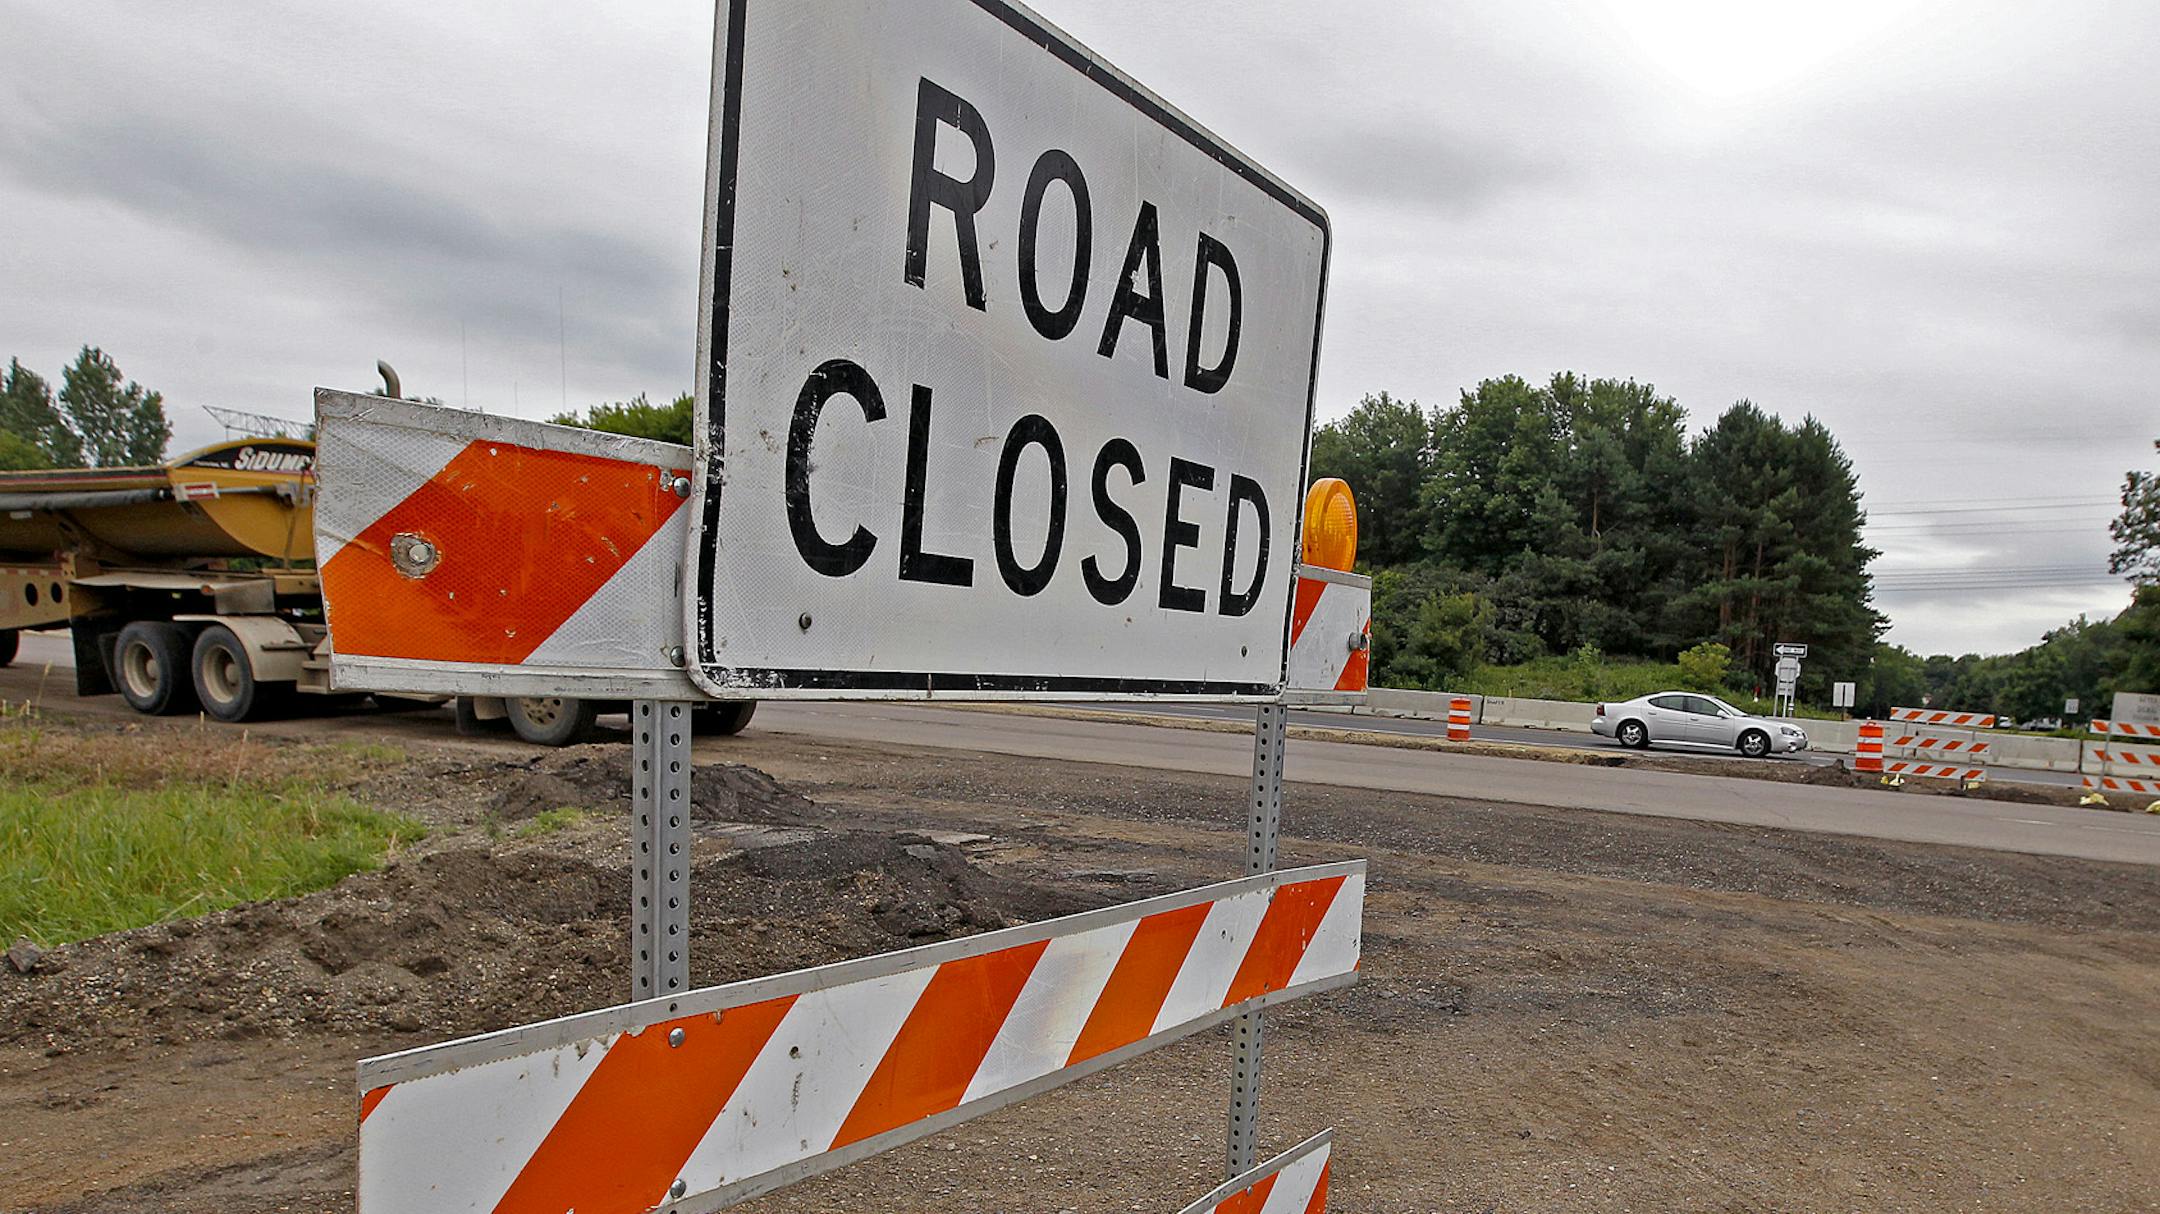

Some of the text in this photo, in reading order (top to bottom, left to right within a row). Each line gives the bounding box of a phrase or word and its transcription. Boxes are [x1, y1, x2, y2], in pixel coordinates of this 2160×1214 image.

[904, 77, 1242, 395] ROAD
[234, 446, 316, 471] SIDUMP
[785, 359, 1270, 617] CLOSED
